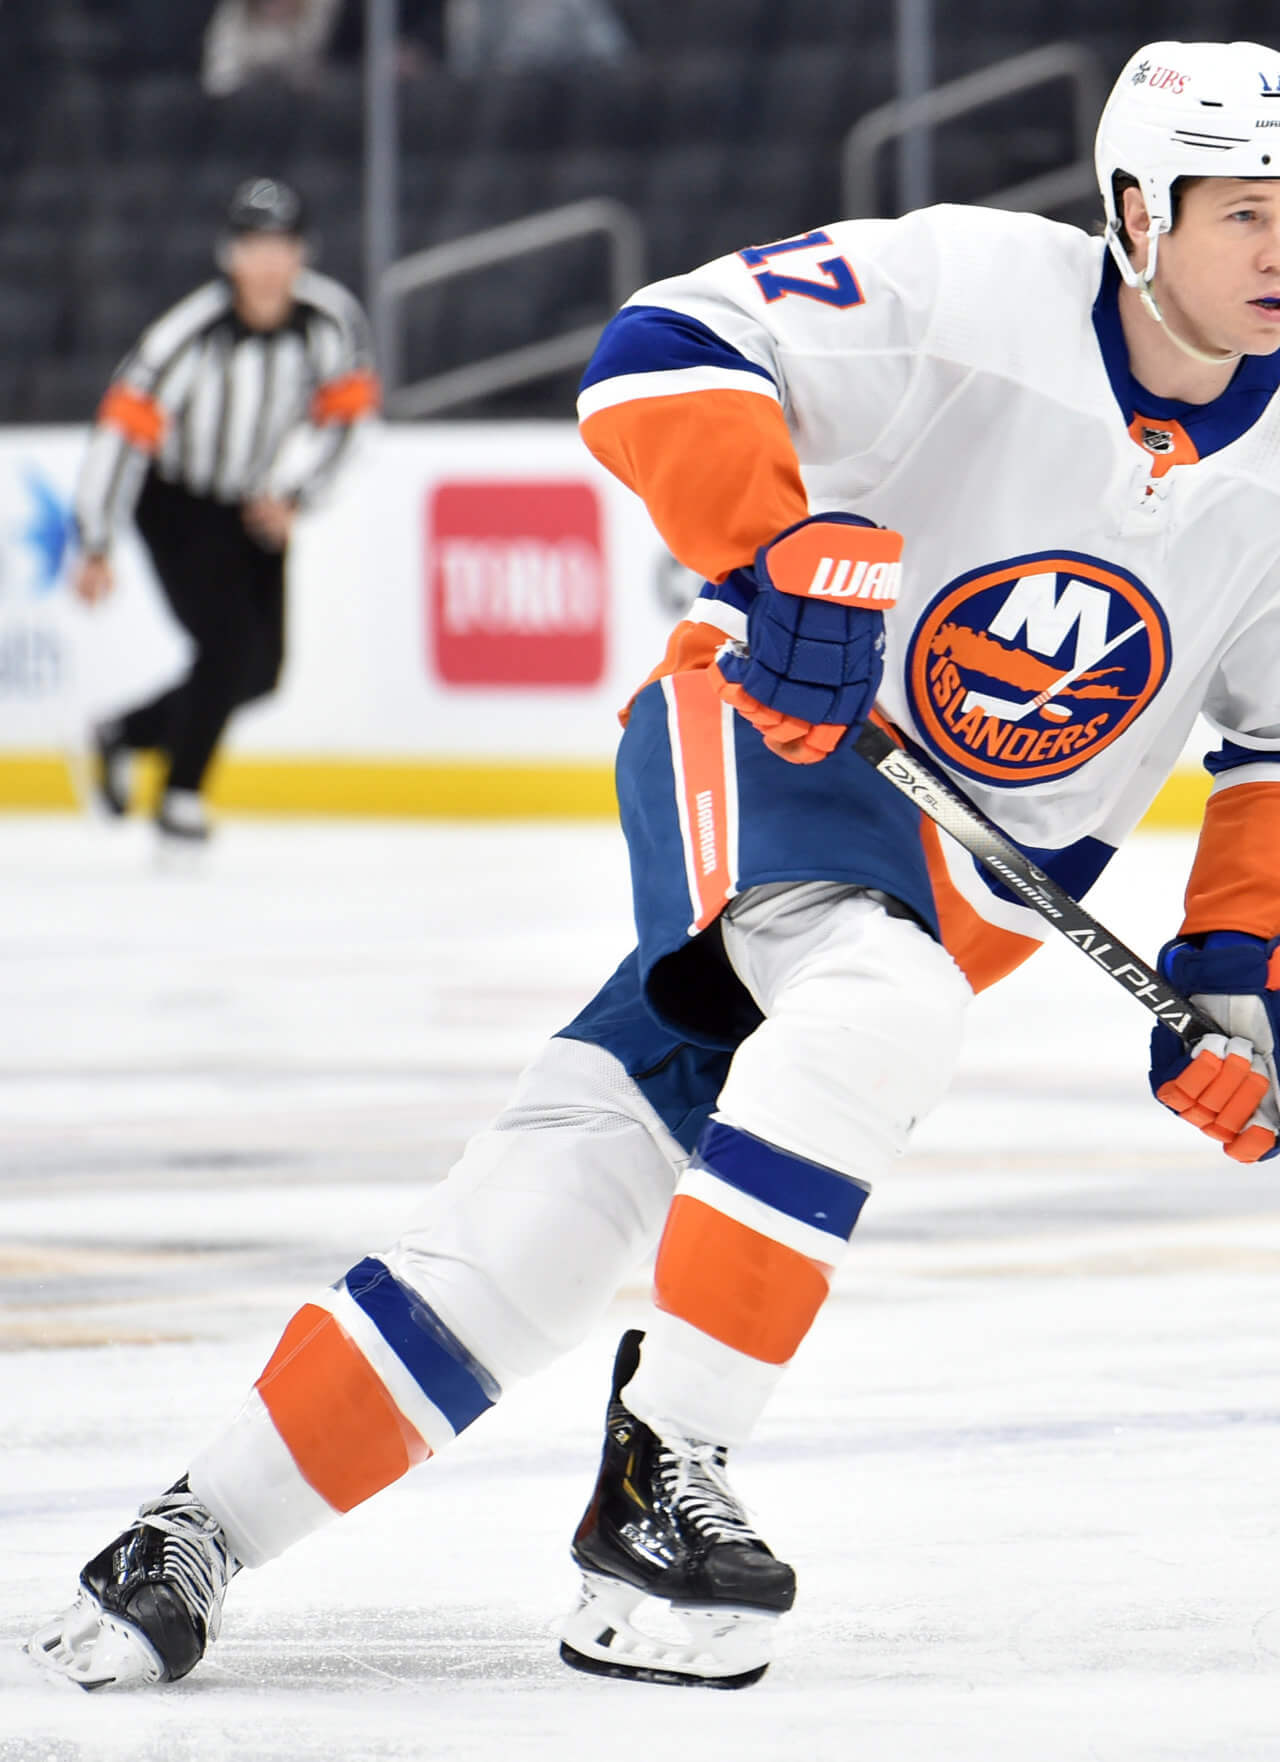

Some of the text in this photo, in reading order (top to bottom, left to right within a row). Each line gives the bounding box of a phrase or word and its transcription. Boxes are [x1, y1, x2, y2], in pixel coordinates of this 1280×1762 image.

[1149, 67, 1191, 94] UBS
[735, 231, 866, 309] 17
[930, 656, 1109, 762] ISLANDERS
[696, 790, 717, 875] WARRIOR
[986, 856, 1192, 1033] WARRIOR ALPHA
